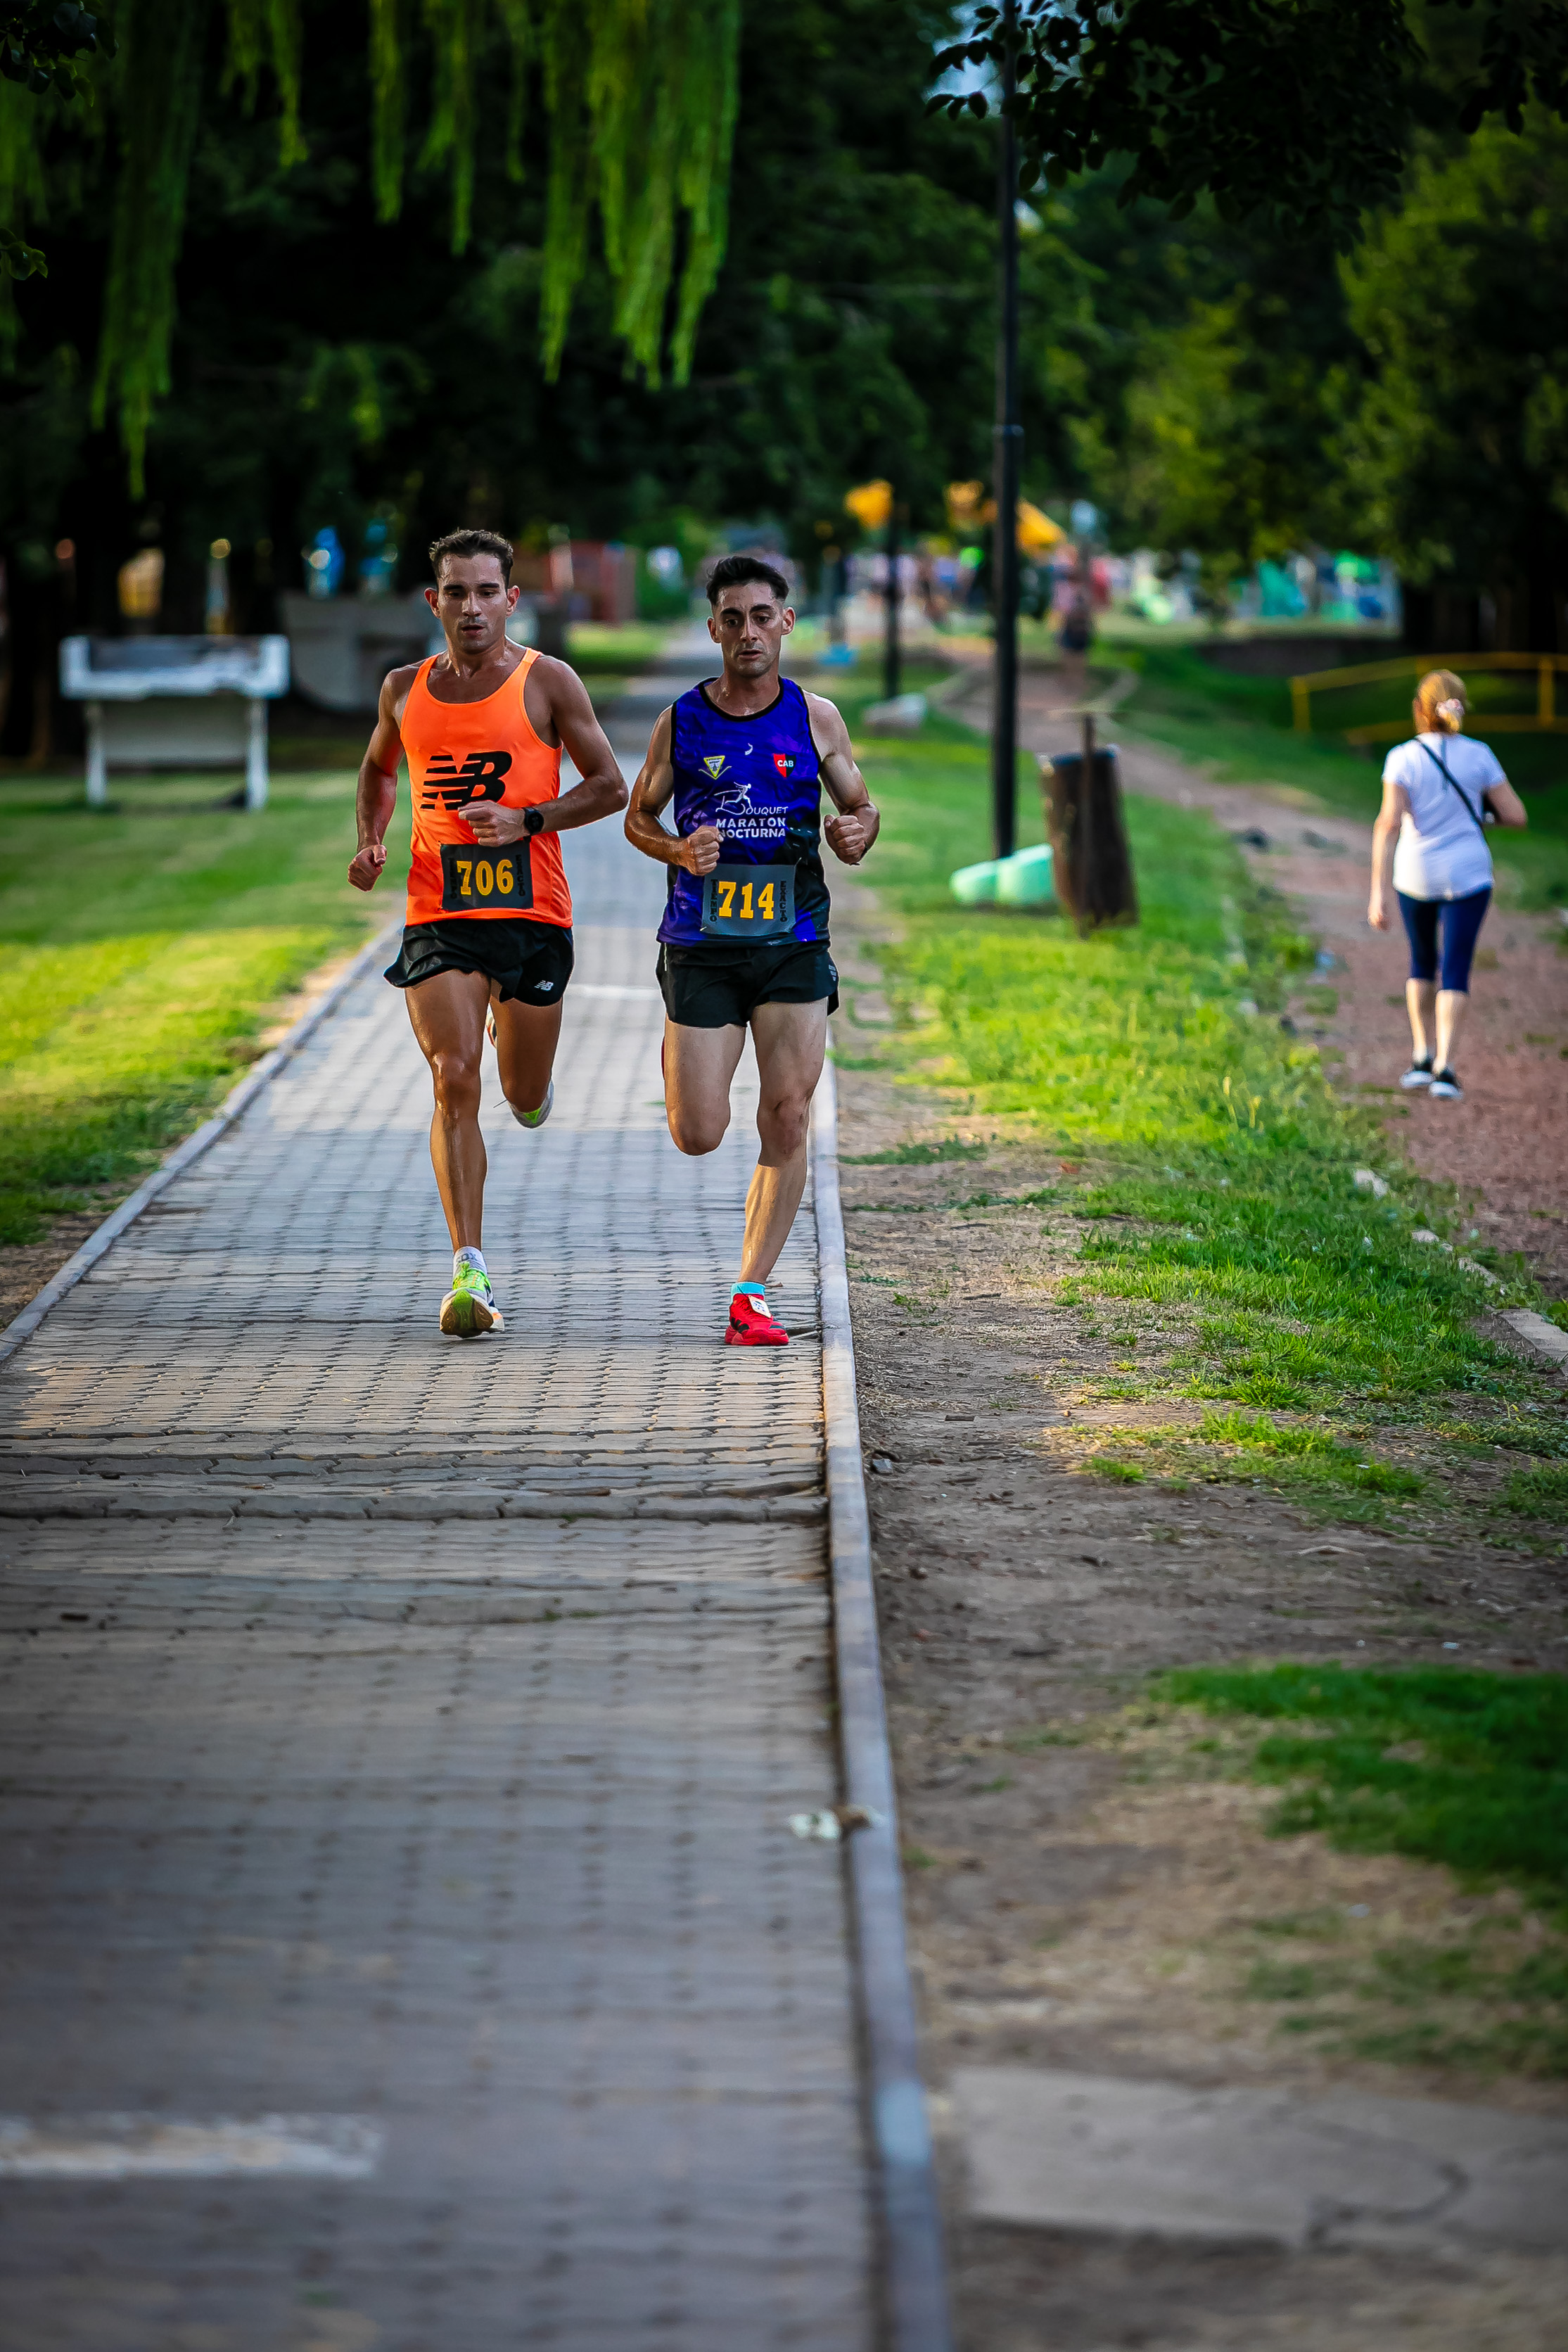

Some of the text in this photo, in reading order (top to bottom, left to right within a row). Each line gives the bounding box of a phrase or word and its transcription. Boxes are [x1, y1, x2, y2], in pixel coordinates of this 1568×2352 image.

[777, 759, 794, 768] CAB
[716, 818, 786, 828] MARATON
[719, 828, 786, 839] NOCTURNA
[457, 859, 514, 896] 706
[709, 879, 718, 922] TIEMPO
[718, 881, 775, 920] 714
[779, 880, 788, 922] EXACTO
